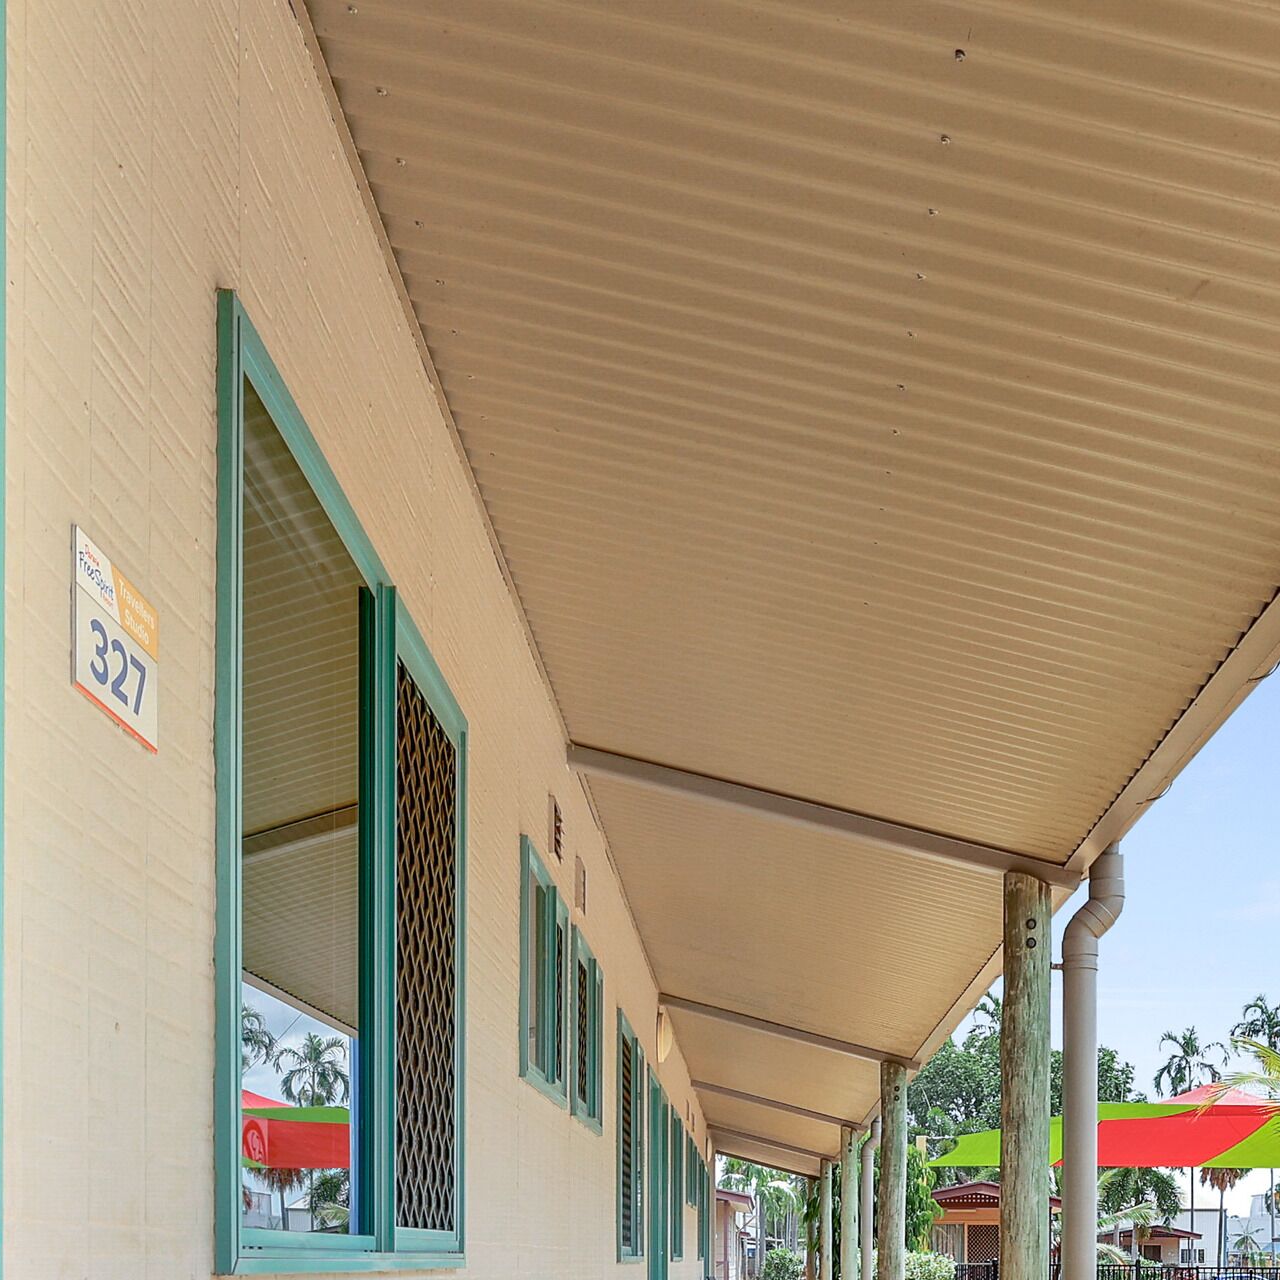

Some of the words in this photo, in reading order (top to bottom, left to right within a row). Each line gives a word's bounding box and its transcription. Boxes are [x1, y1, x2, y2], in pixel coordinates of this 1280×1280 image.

[119, 578, 155, 630] Travellers
[124, 608, 150, 645] Studio
[90, 618, 146, 716] 327
